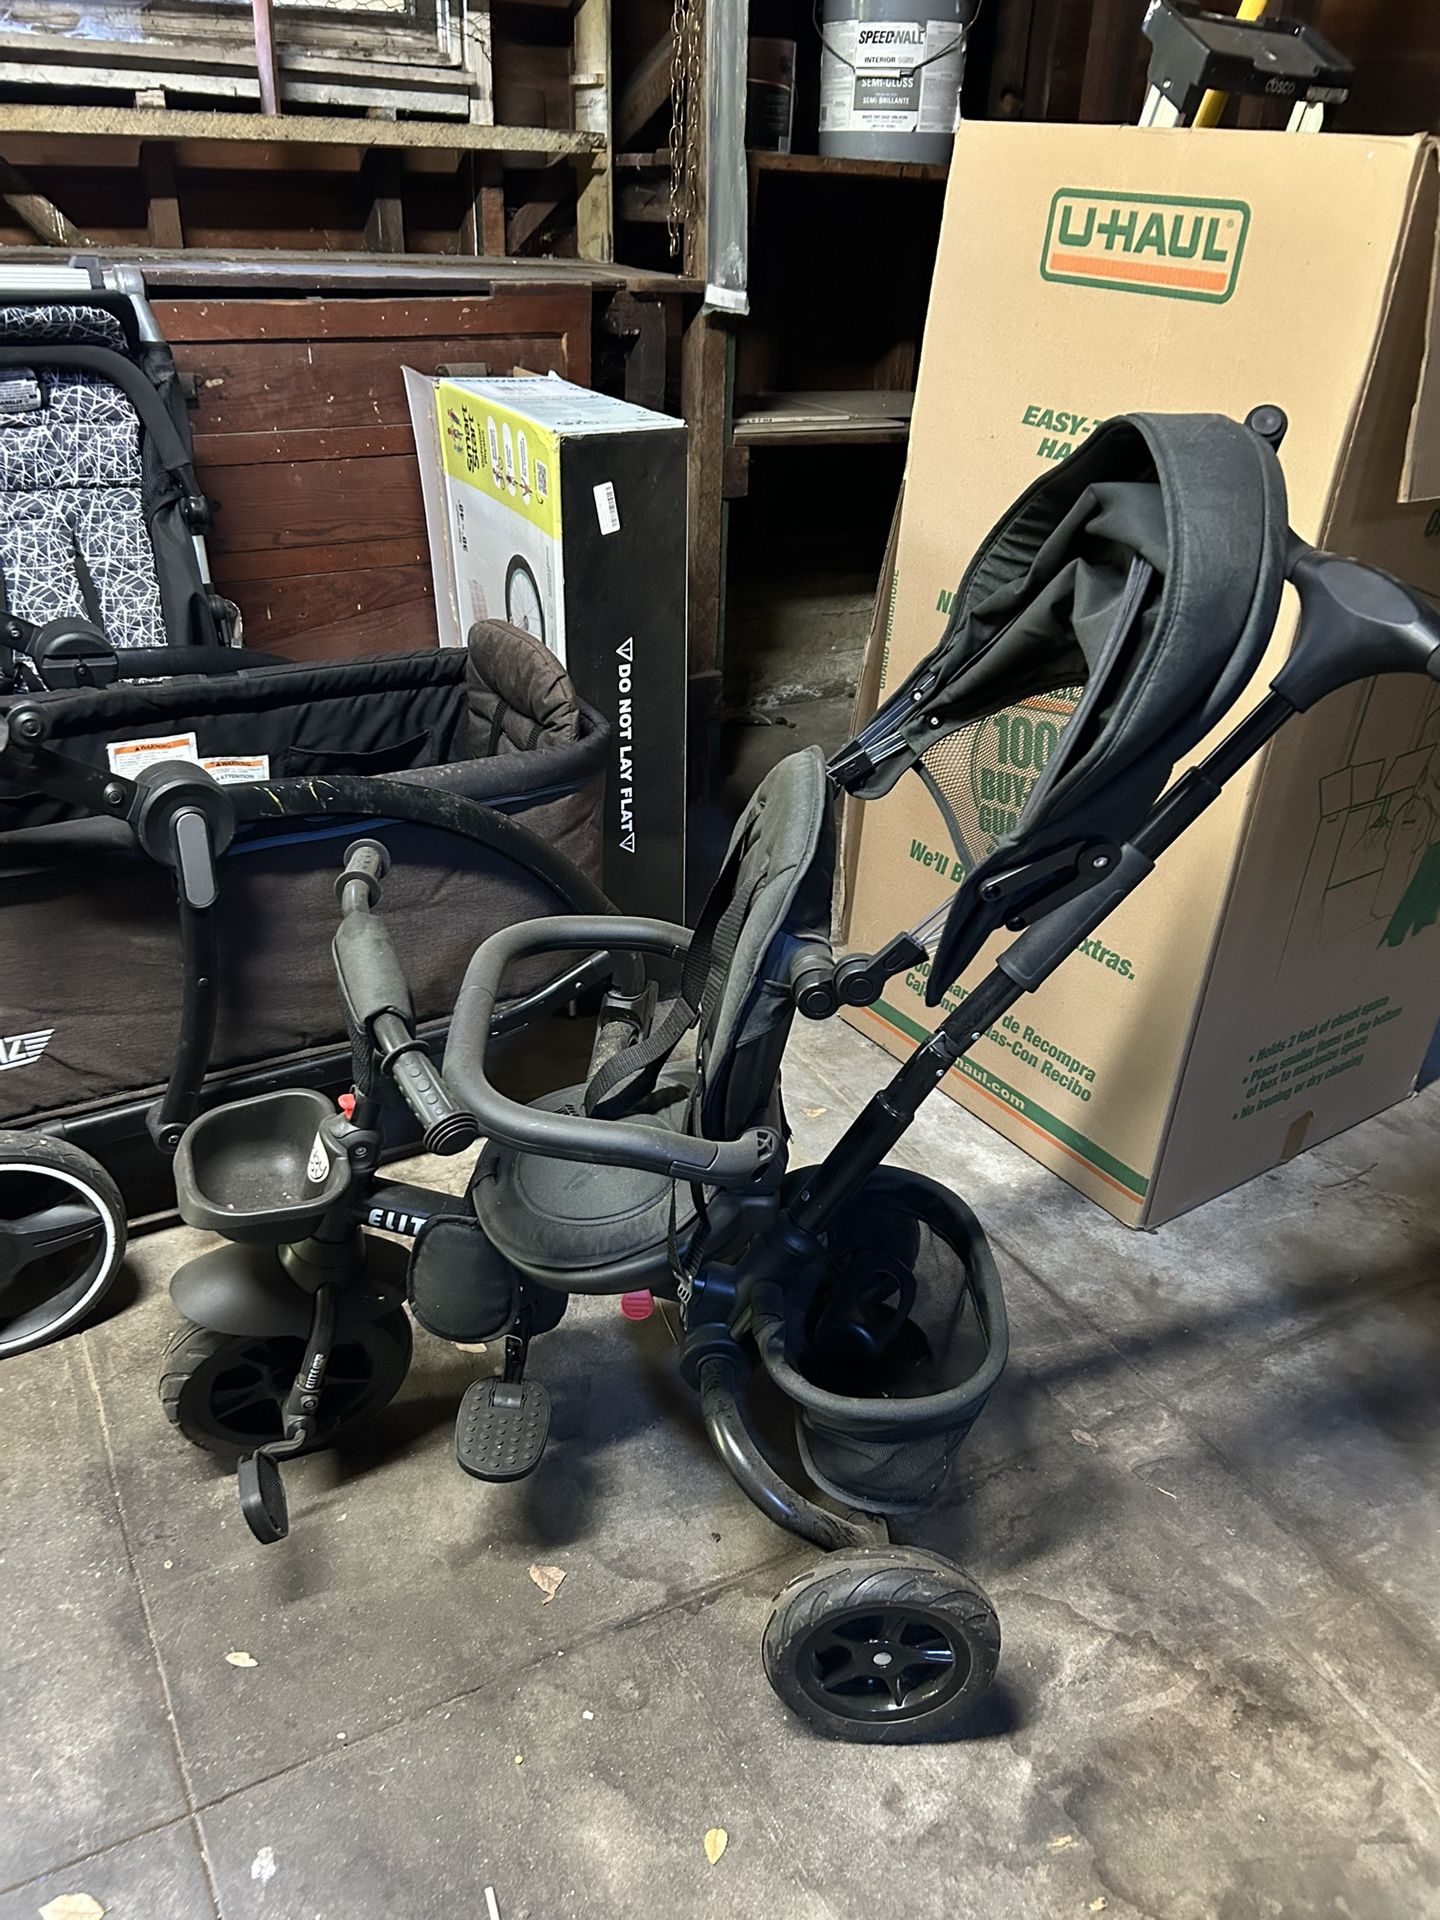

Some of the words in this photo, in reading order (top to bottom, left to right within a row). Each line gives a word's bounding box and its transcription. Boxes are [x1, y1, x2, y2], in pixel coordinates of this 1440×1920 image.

[858, 30, 925, 45] SPEEDWALL
[861, 77, 914, 88] SEMI-GLOSS
[1264, 79, 1296, 94] COSCO
[1058, 205, 1229, 263] U-HAUL
[1036, 437, 1079, 461] HA
[618, 663, 632, 693] DO
[618, 698, 632, 740] NOT
[140, 742, 172, 751] WARNING
[619, 745, 633, 782] LAY
[993, 714, 1068, 772] 100
[980, 767, 1033, 807] BUY
[620, 786, 633, 832] FLAT
[1077, 938, 1136, 981] xtras.
[905, 972, 927, 997] Caj
[1041, 1063, 1092, 1102] Recibo
[1001, 1014, 1020, 1034] de
[1023, 1025, 1097, 1083] Recompra
[1255, 1041, 1286, 1062] Holds
[1287, 1034, 1297, 1048] 2
[1297, 1024, 1318, 1044] feet
[1318, 1018, 1331, 1034] of
[1246, 1084, 1259, 1099] of
[1259, 1076, 1279, 1093] box
[1280, 1070, 1292, 1083] to
[1292, 1048, 1339, 1078] maximize
[1250, 1063, 1278, 1084] Place
[1279, 1046, 1316, 1070] smaller
[1240, 1104, 1255, 1119] No
[1293, 1081, 1307, 1094] or
[1306, 1071, 1324, 1089] dry
[1324, 1053, 1364, 1080] cleaning
[368, 1208, 428, 1236] ELIT
